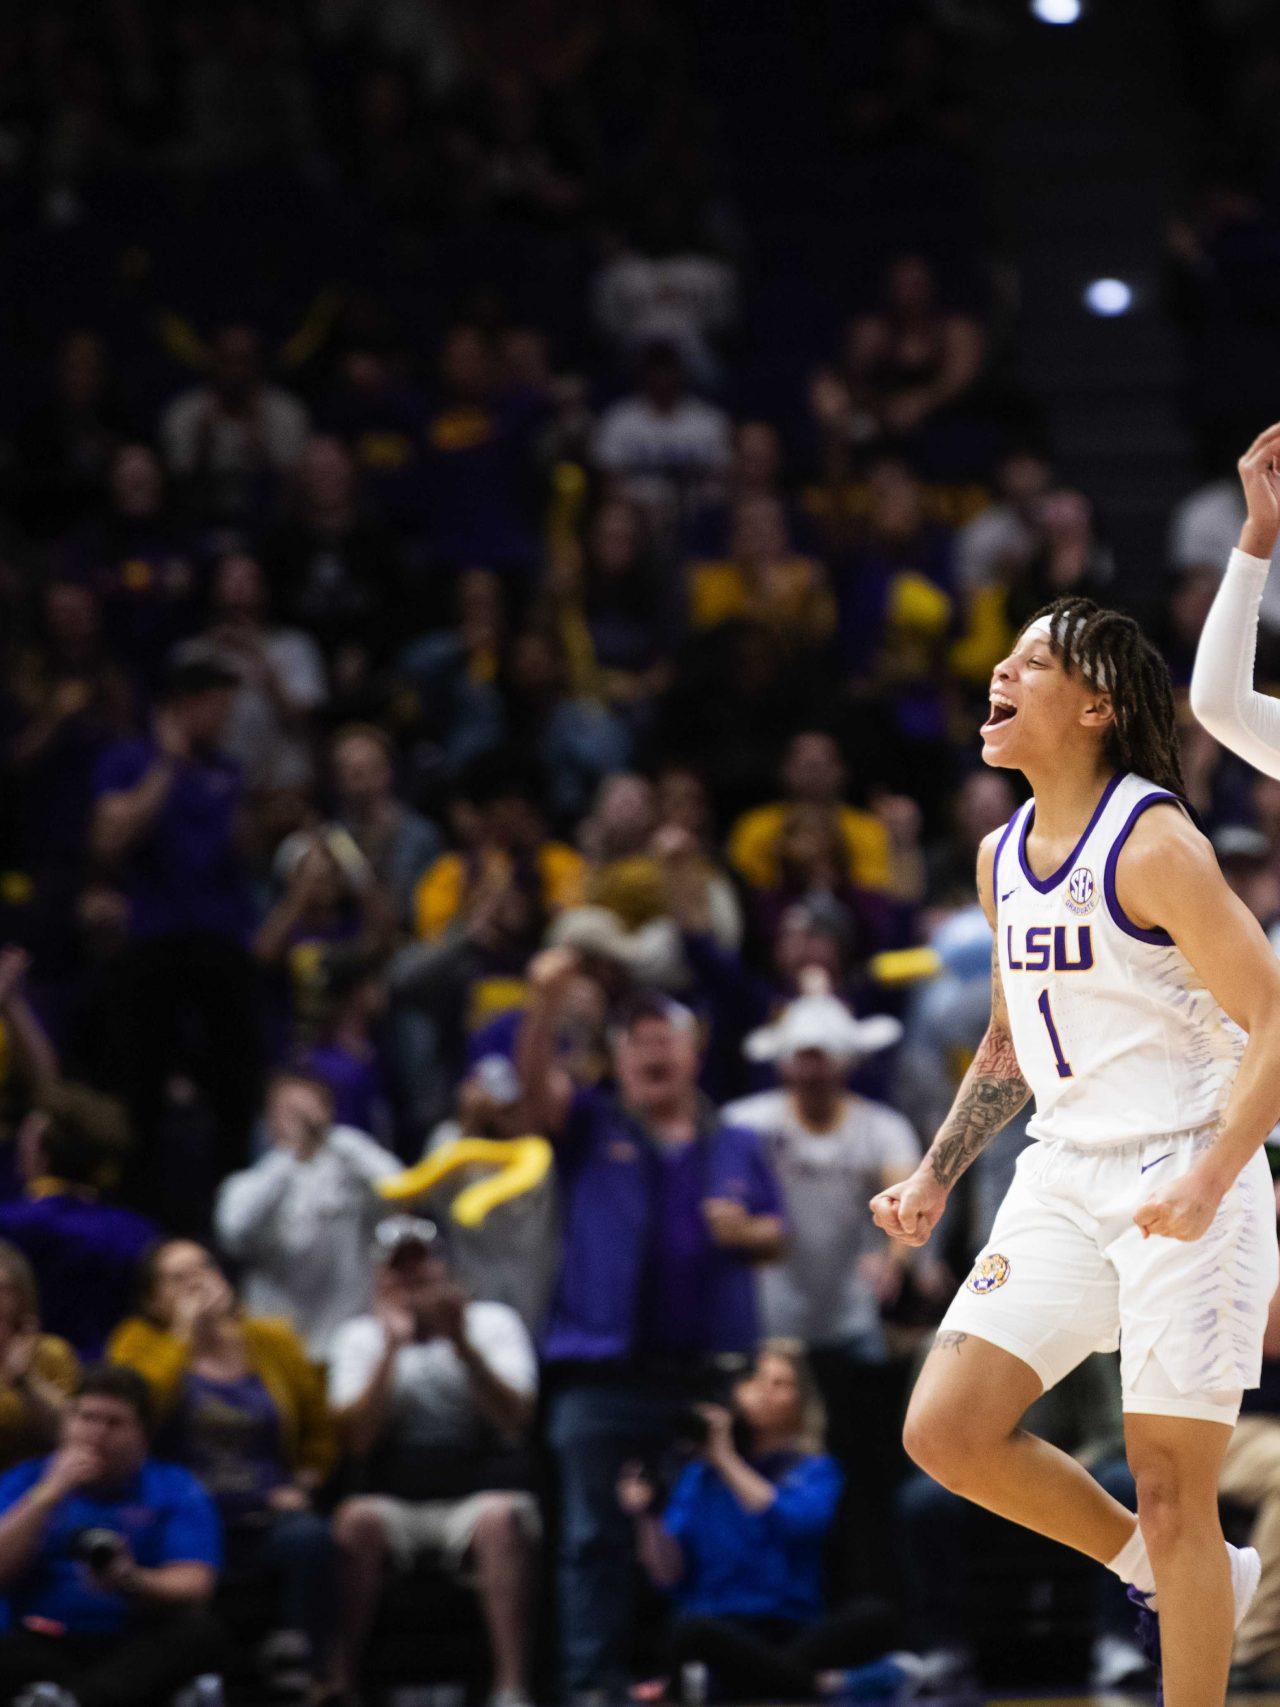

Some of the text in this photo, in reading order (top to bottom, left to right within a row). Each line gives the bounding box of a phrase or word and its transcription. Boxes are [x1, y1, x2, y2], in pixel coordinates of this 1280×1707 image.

[1070, 868, 1093, 904] SEC
[1007, 925, 1094, 972] LSU
[1037, 988, 1074, 1078] 1
